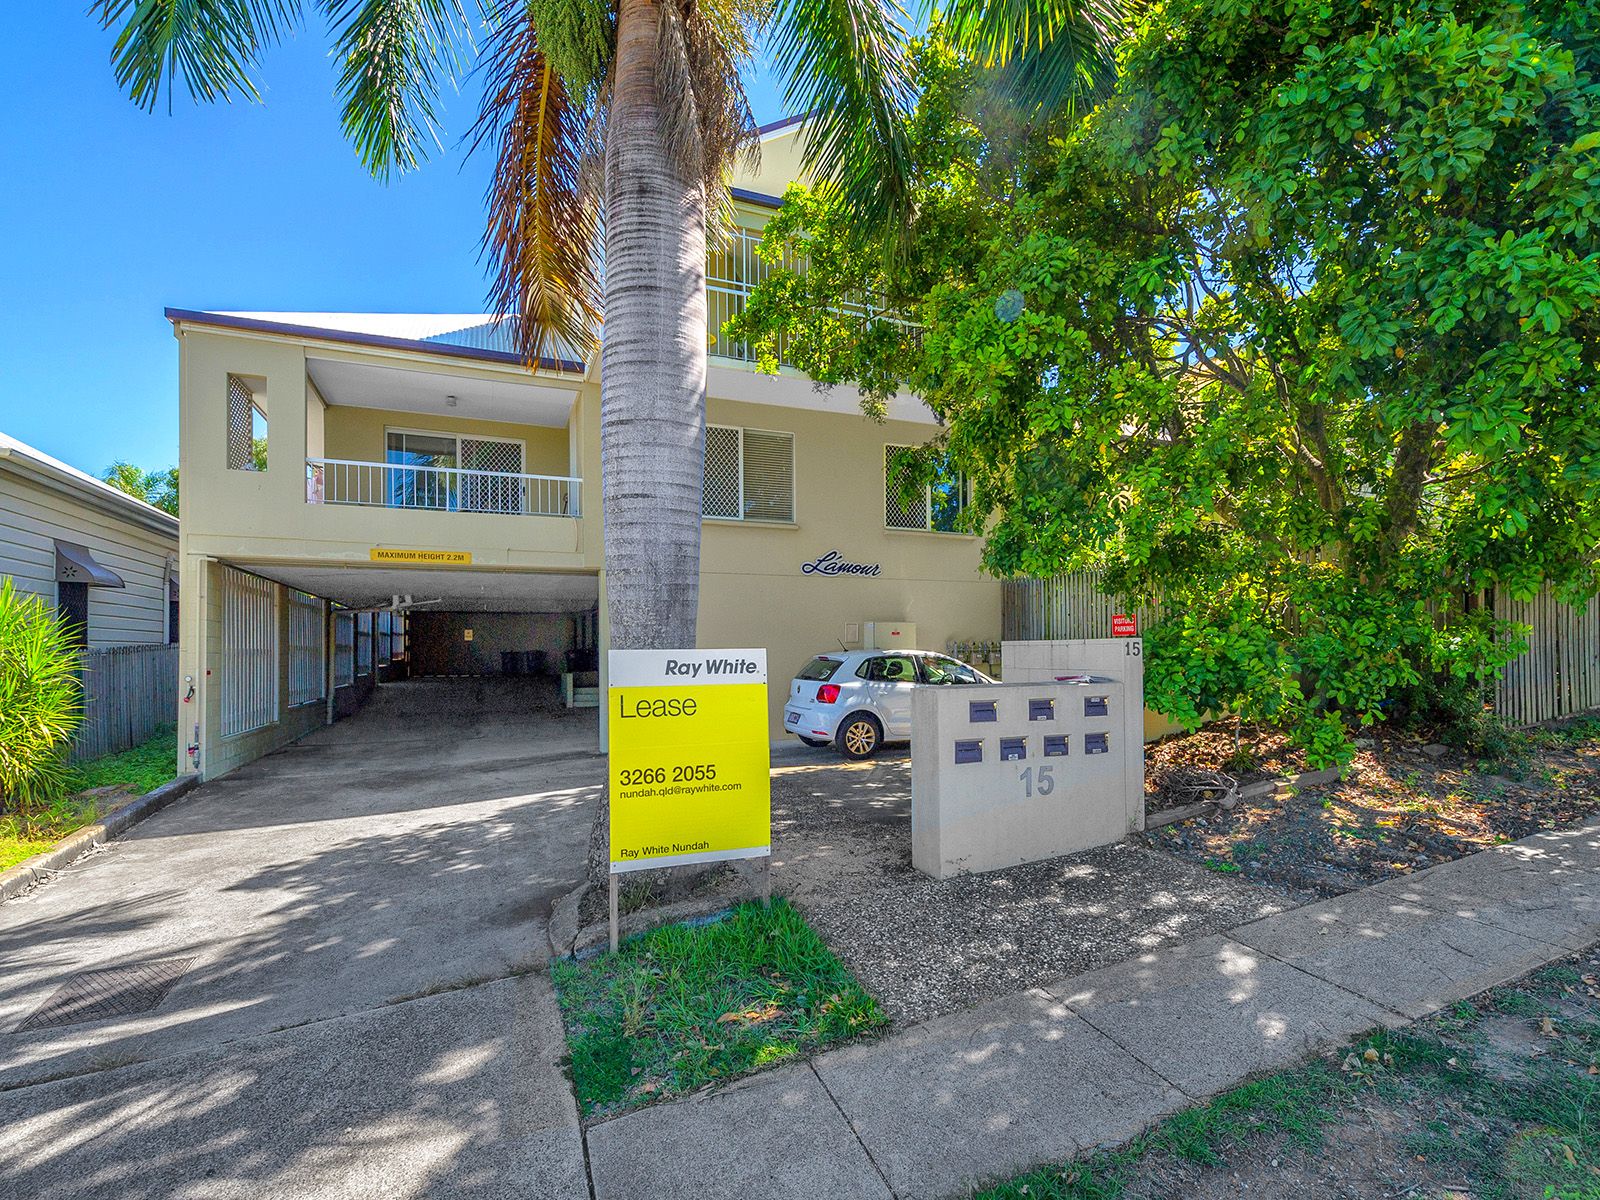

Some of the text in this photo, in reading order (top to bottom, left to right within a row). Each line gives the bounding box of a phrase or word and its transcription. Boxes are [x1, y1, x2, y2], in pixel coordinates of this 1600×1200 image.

[377, 551, 416, 559] MAXIMUM
[1114, 625, 1135, 633] PARKING
[1125, 641, 1141, 656] 15
[665, 659, 702, 678] Ray
[620, 694, 697, 718] Lease
[619, 764, 717, 786] 3266 2055
[1019, 765, 1055, 797] 15
[619, 782, 742, 799] nundah.qld@raywhite.com
[620, 841, 710, 859] Ray White Nundah
